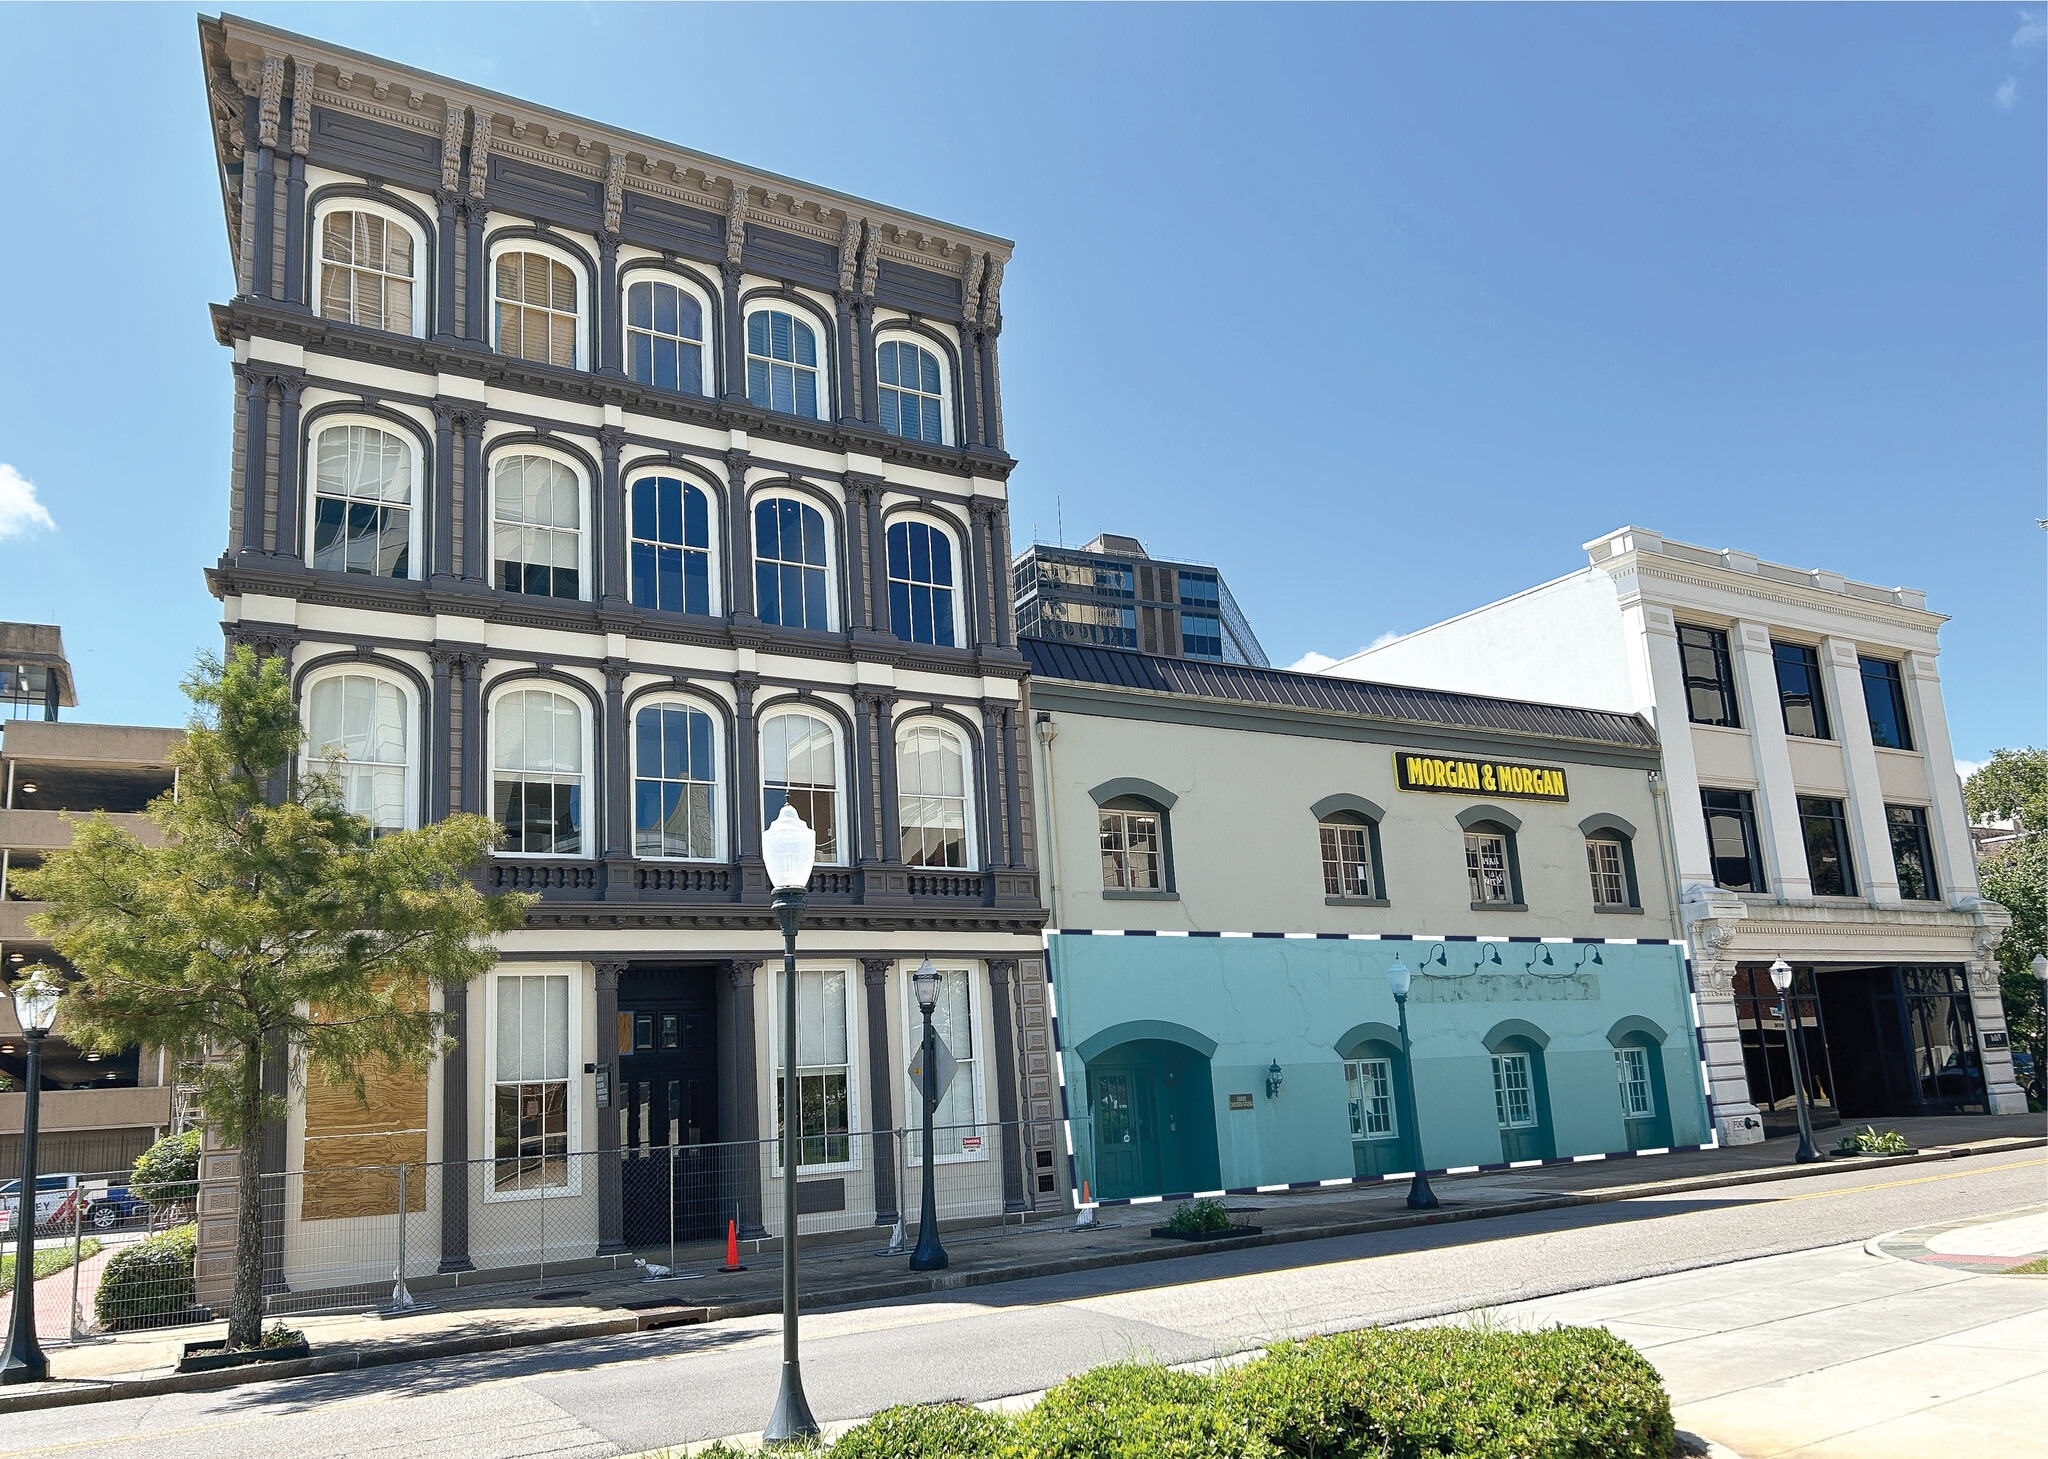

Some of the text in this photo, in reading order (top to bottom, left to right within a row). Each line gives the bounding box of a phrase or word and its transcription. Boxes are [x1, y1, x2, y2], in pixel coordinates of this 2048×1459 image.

[1406, 757, 1565, 797] MORGAN & MORGAN
